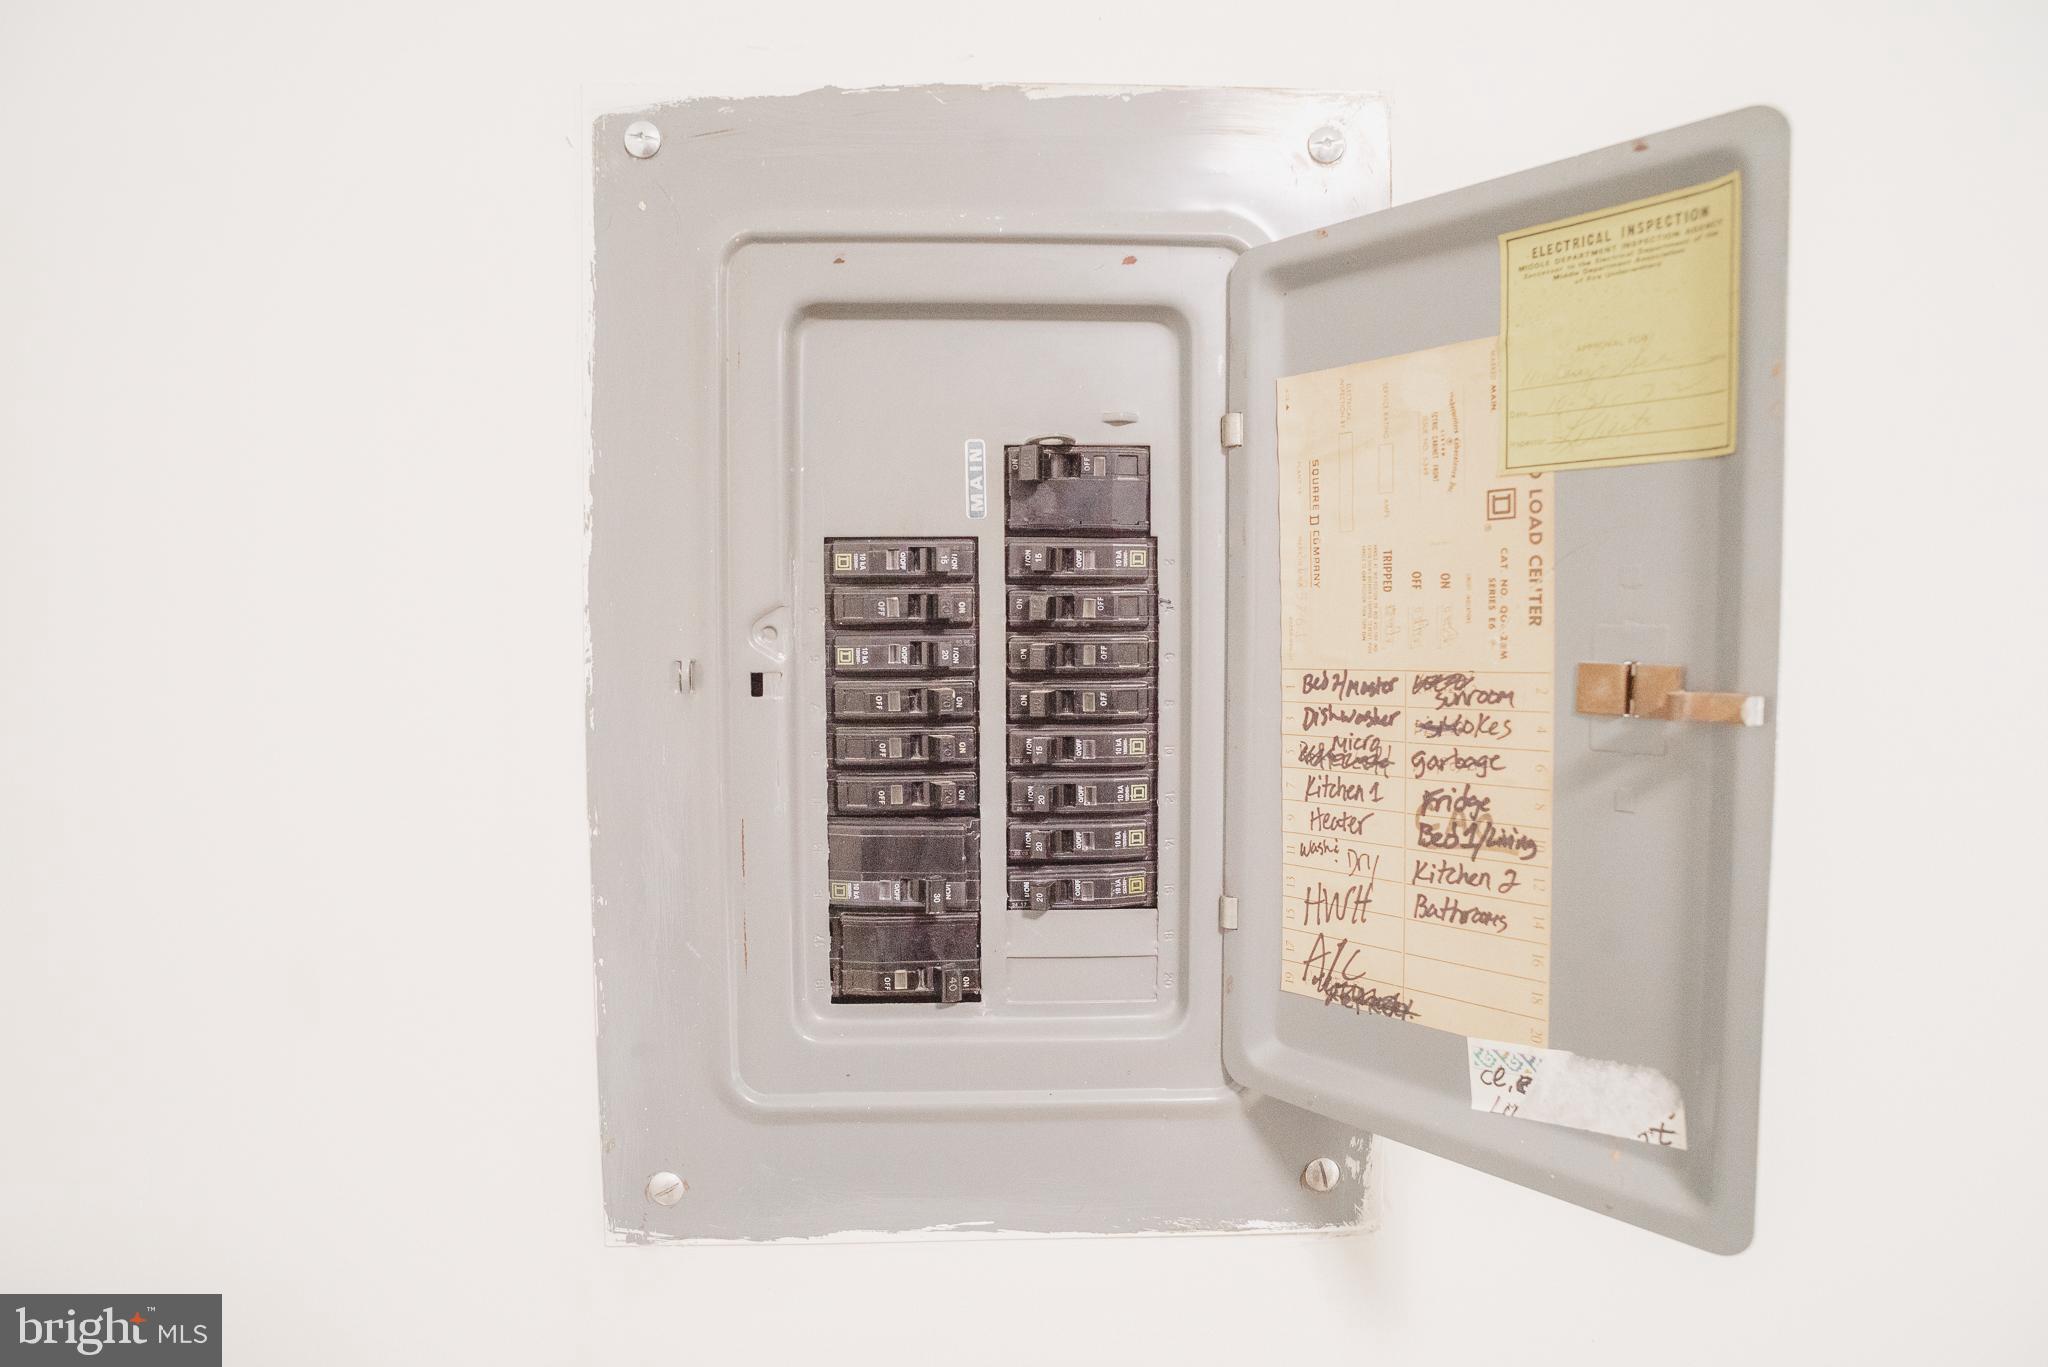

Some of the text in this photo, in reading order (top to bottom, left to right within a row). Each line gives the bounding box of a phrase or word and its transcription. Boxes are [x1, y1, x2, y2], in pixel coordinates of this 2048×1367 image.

[1531, 230, 1612, 259] ELECTRICAL
[1621, 206, 1709, 239] INSPECTION
[1012, 459, 1018, 470] ON
[970, 446, 984, 512] MAIN
[1311, 459, 1320, 512] SQUARE
[1529, 489, 1543, 545] LOAD
[860, 553, 866, 561] 10
[941, 555, 948, 564] 15
[1035, 553, 1042, 562] 15
[1116, 559, 1122, 567] 10
[1312, 530, 1321, 589] COMPANY
[1382, 550, 1393, 593] TRIPPED
[1411, 571, 1422, 590] OFF
[1440, 572, 1451, 589] ON
[1488, 577, 1497, 610] SERIES
[959, 601, 965, 614] ON
[1016, 599, 1023, 609] ON
[862, 648, 868, 656] 10
[942, 650, 949, 659] 20
[1020, 646, 1108, 659] ON OFF
[1303, 671, 1329, 694] Bed
[956, 697, 963, 708] ON
[1021, 695, 1028, 706] ON
[1303, 704, 1401, 731] Dishwasher
[959, 742, 966, 753] ON
[1036, 746, 1042, 754] 15
[1116, 738, 1122, 746] kA
[958, 790, 965, 800] ON
[1117, 785, 1124, 793] kA
[1305, 775, 1384, 803] Kitchen 1
[878, 791, 886, 805] OFF
[1038, 795, 1045, 804] 20
[1117, 794, 1124, 802] 10
[1421, 783, 1491, 820] Fridge
[1310, 807, 1375, 835] Heater
[1036, 842, 1042, 851] 20
[1115, 831, 1121, 839] kA
[1417, 821, 1460, 850] Bed
[1412, 859, 1521, 894] Kitchen 2
[853, 883, 859, 892] 10
[933, 893, 941, 903] 30
[1037, 893, 1043, 902] 20
[1304, 882, 1374, 926] HWH
[1302, 932, 1367, 983] A/C
[949, 977, 957, 991] 40
[963, 977, 970, 987] ON
